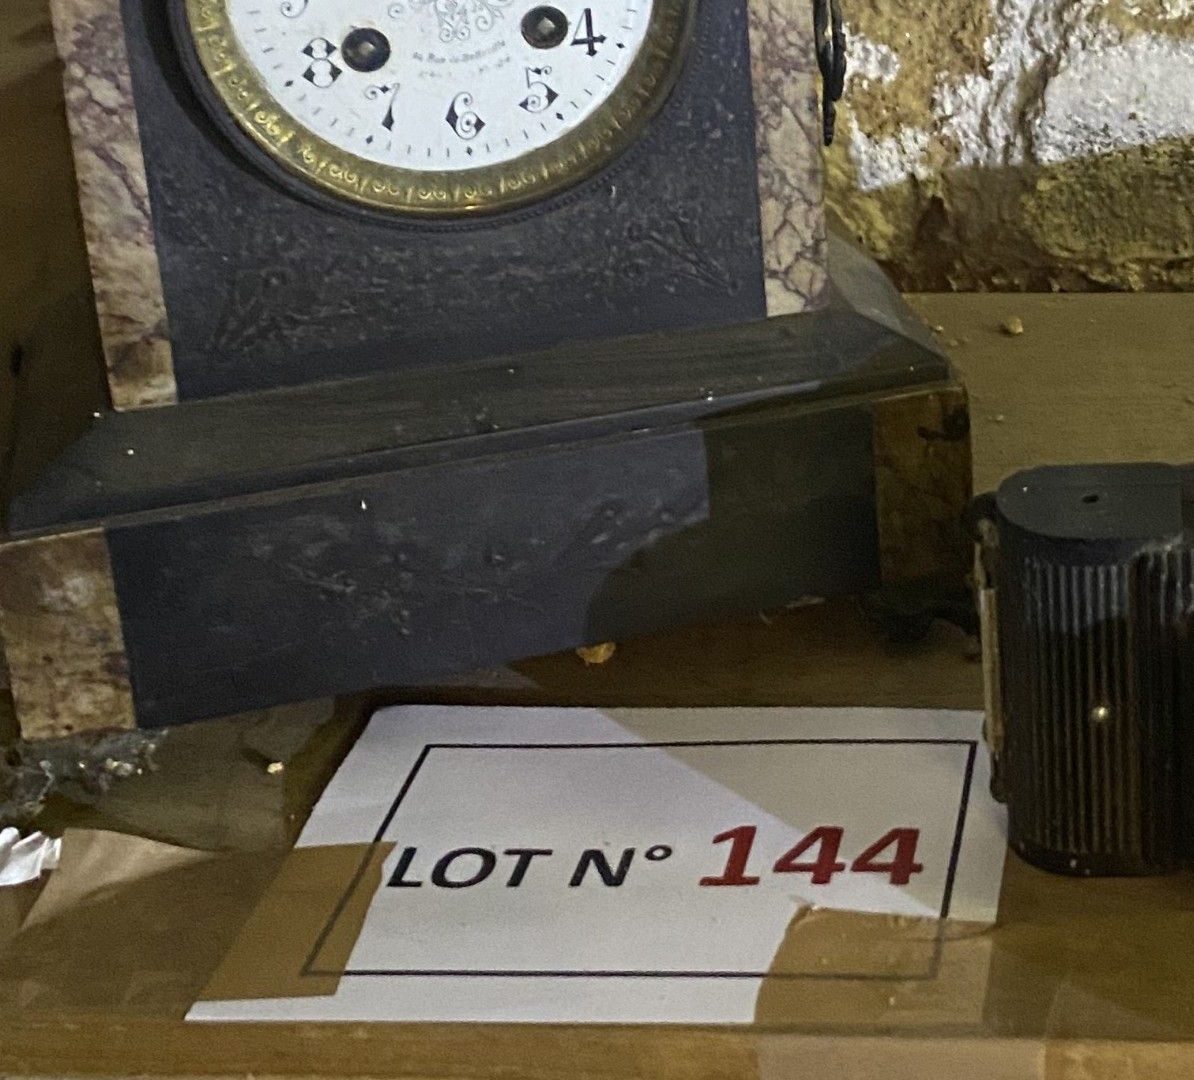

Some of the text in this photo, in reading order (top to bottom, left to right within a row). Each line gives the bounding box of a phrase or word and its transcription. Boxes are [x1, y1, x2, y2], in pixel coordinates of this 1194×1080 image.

[570, 8, 608, 57] 4
[302, 37, 342, 88] 8
[365, 83, 401, 132] 7
[519, 66, 560, 113] 5
[446, 92, 486, 141] 6
[387, 825, 924, 888] LOT N° 144
